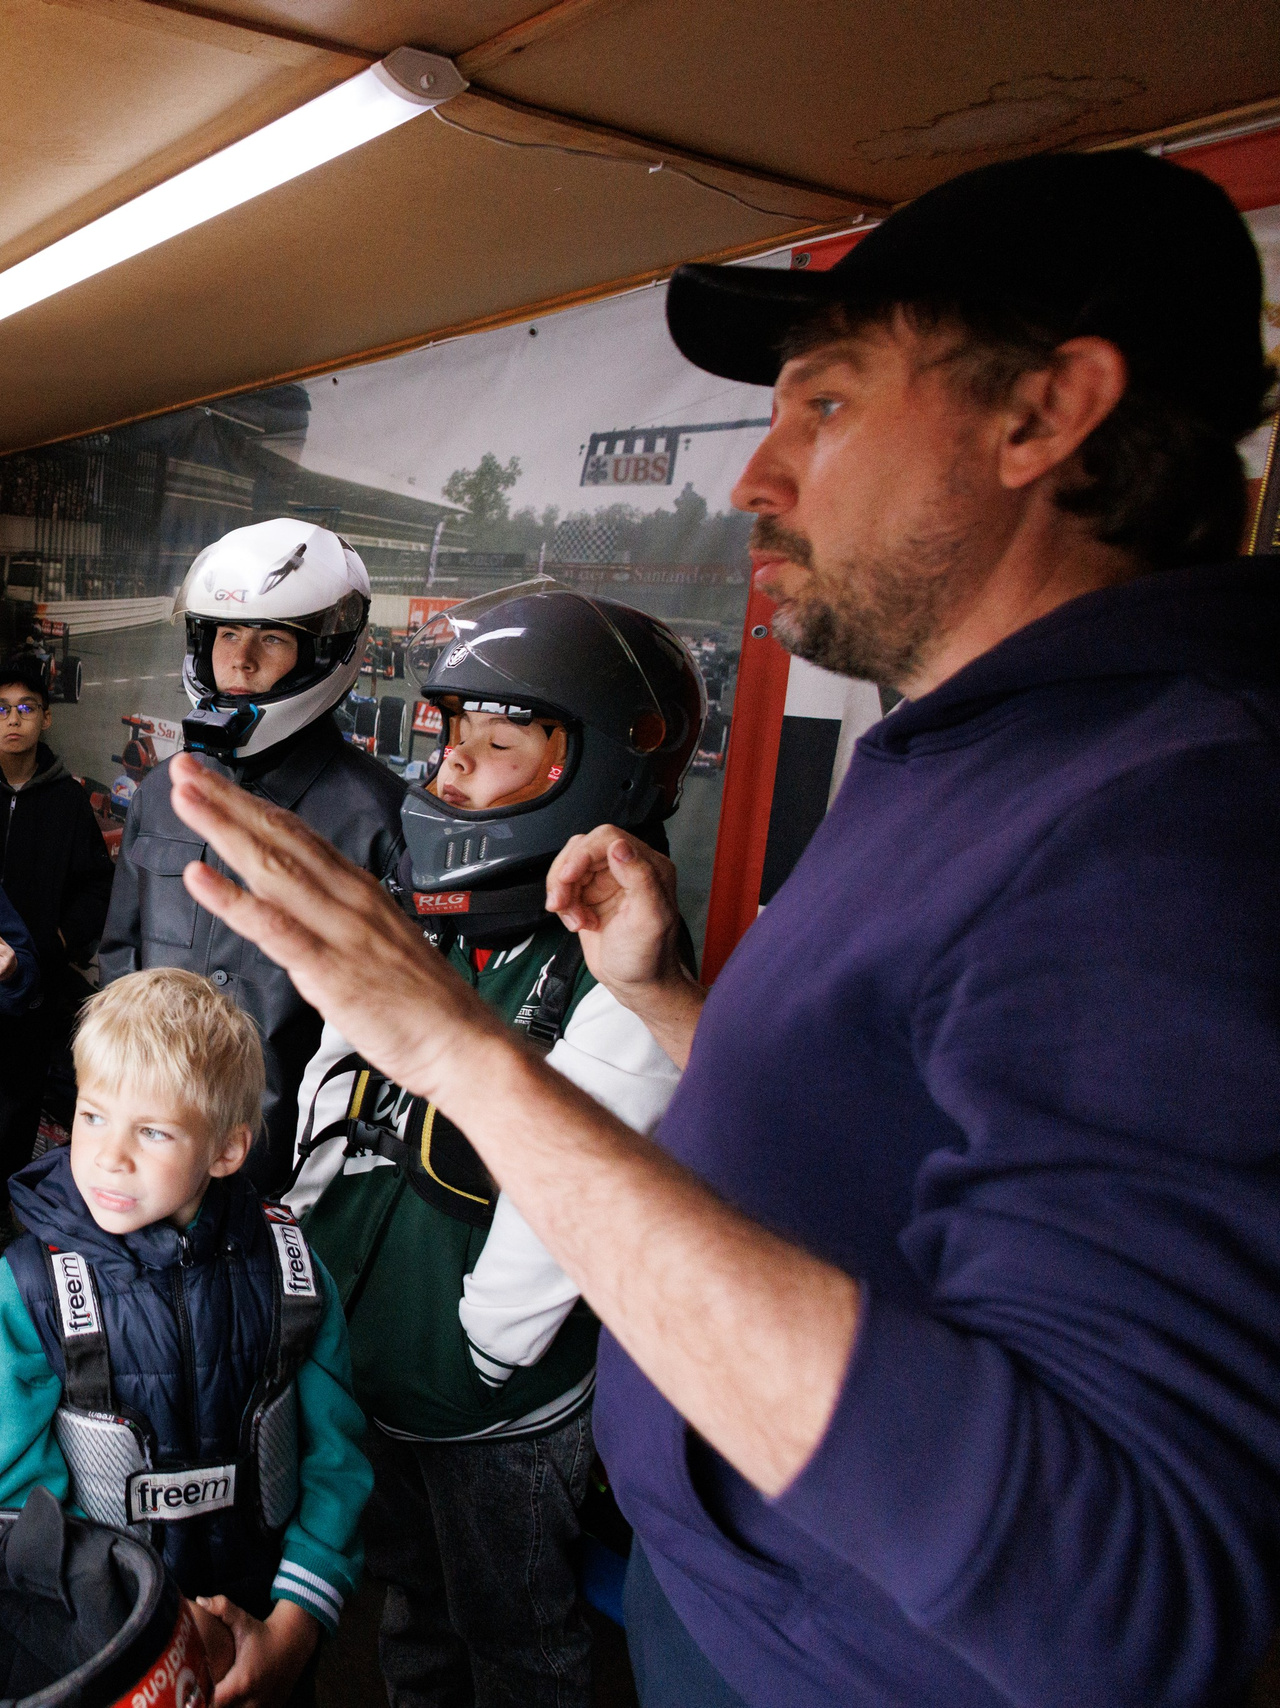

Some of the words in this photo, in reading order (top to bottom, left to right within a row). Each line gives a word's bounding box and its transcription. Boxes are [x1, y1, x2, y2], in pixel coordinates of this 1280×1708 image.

[613, 456, 669, 483] UBS
[214, 588, 250, 604] GXT
[418, 893, 466, 907] RLG
[281, 1226, 311, 1292] freem
[61, 1256, 93, 1332] freem
[138, 1479, 229, 1512] freem
